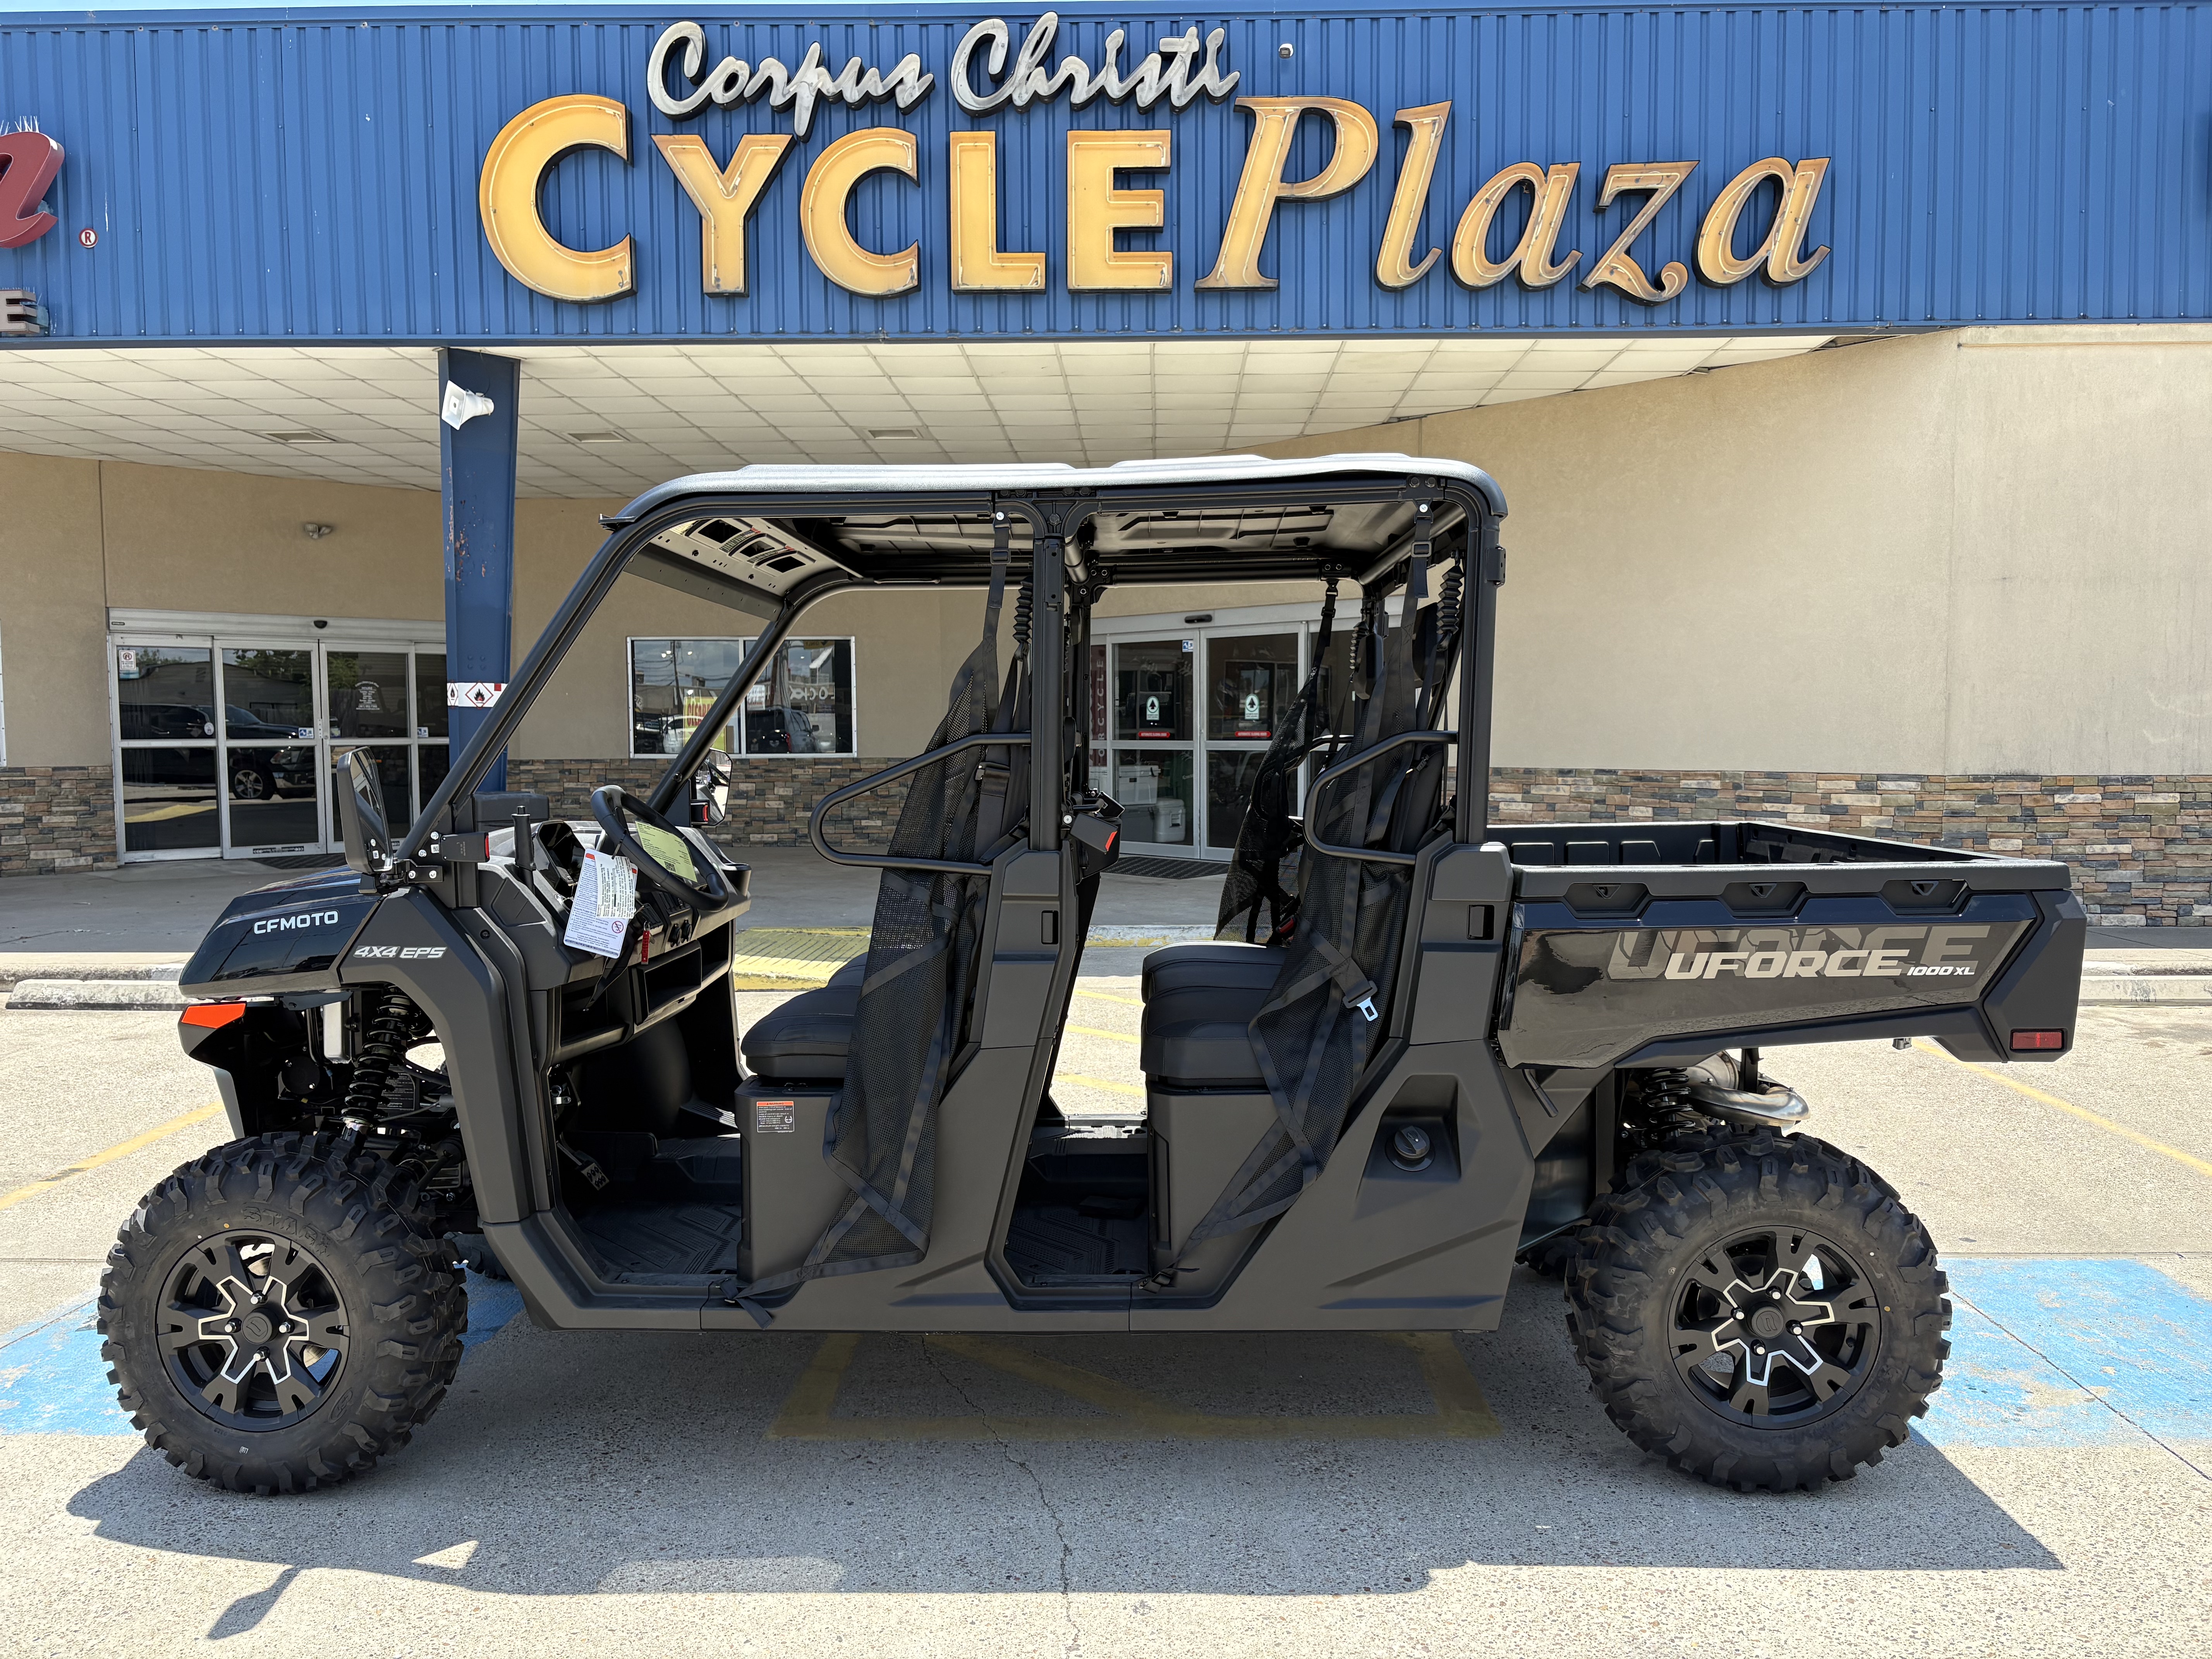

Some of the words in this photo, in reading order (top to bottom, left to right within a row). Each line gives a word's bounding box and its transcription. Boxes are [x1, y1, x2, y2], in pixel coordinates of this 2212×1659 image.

[647, 20, 934, 143] Corpus
[951, 11, 1241, 118] Christi
[479, 93, 1173, 304] CYCLE
[1194, 95, 1831, 307] Plaza
[1096, 660, 1104, 758] ORCYCLE
[254, 911, 339, 934] CFMOTO
[354, 946, 399, 958] 4X4
[399, 947, 447, 958] EPS
[1664, 949, 1910, 980] UFORCE
[1906, 966, 1953, 976] 1000
[1953, 967, 1975, 975] XL
